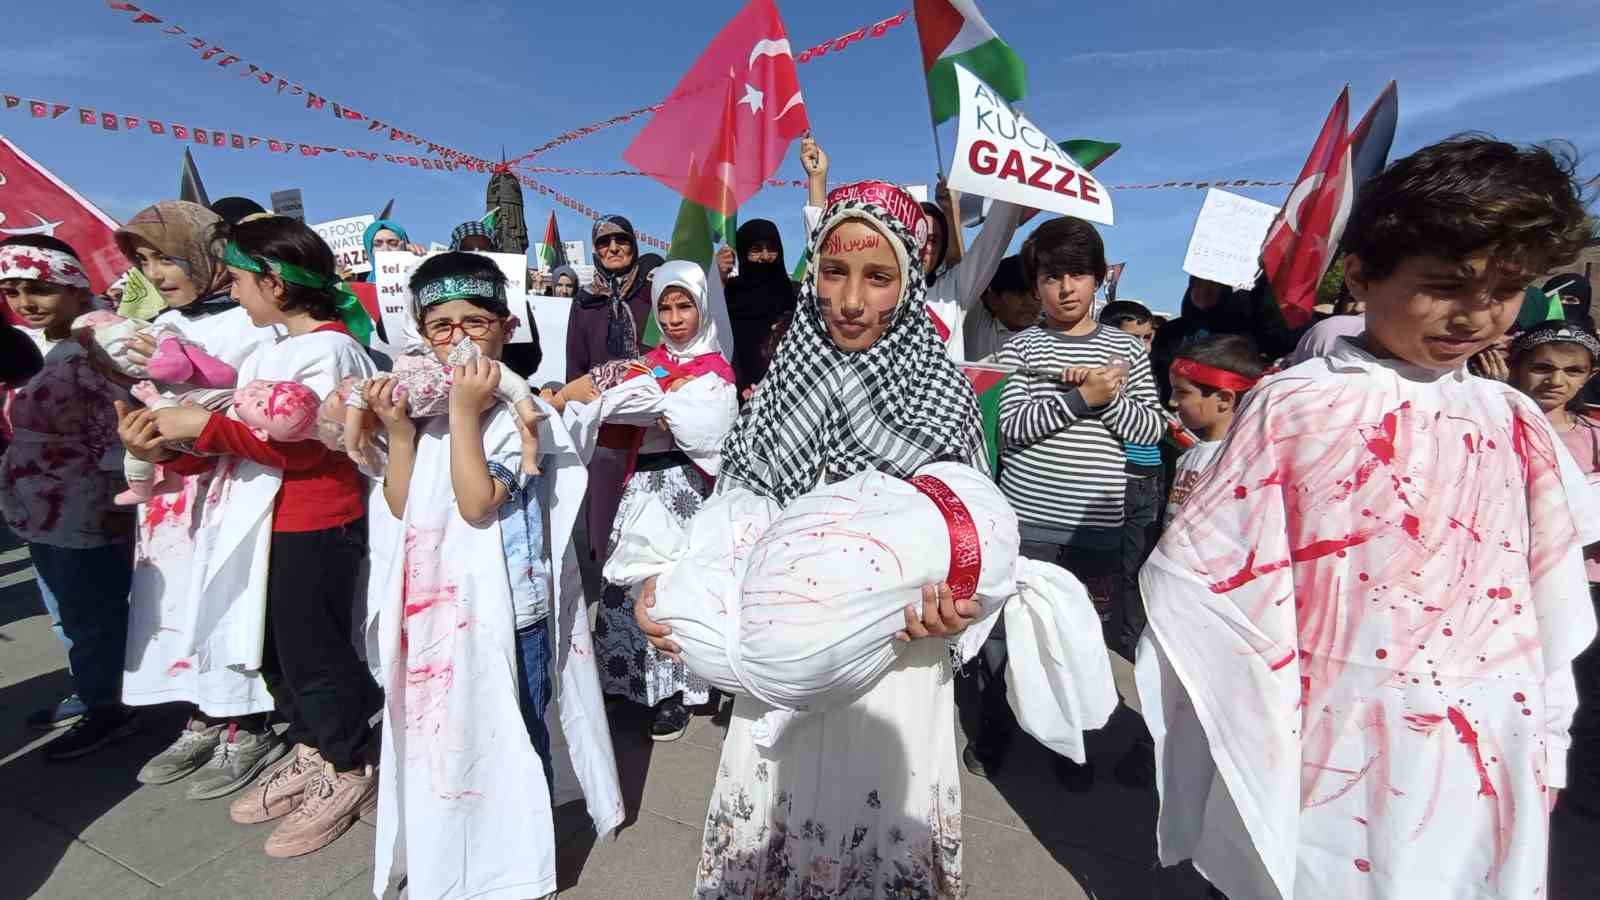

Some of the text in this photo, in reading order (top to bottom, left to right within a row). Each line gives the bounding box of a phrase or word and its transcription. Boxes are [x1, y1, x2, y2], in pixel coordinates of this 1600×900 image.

[968, 139, 1100, 205] GAZZE
[329, 221, 366, 237] FOOD
[330, 235, 363, 249] WATE
[382, 263, 400, 274] tel
